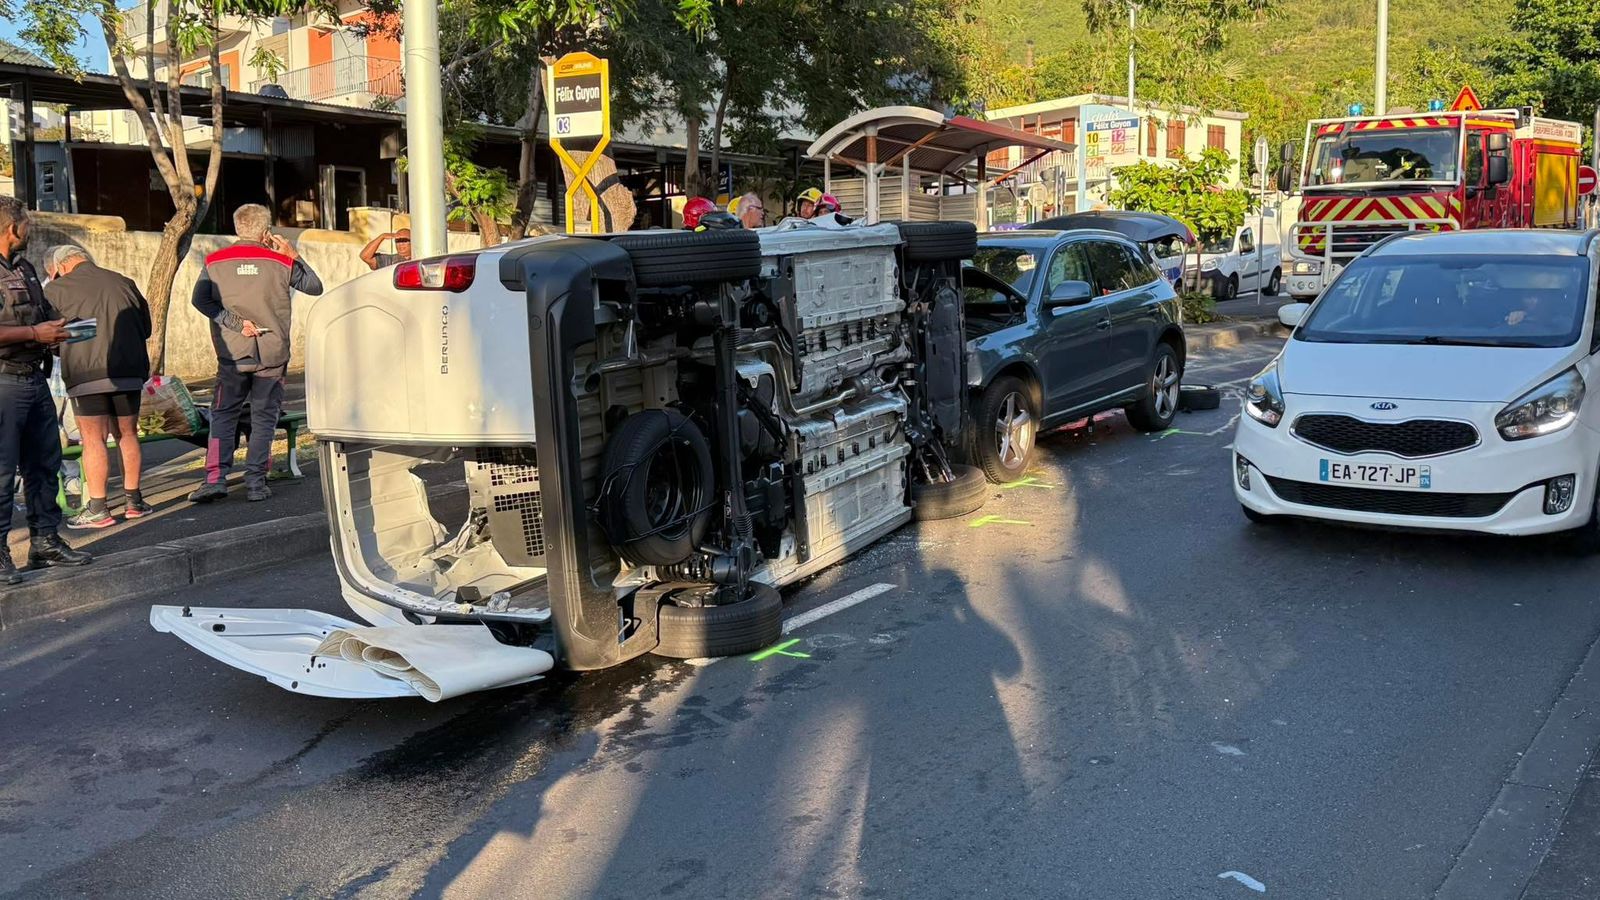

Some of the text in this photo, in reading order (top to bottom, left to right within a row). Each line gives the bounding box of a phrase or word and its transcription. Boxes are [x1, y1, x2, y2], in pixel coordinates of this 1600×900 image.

[556, 85, 600, 102] Félix Guyon
[557, 117, 570, 133] 03
[1093, 120, 1131, 130] Félix Guyon
[1087, 132, 1099, 144] 10
[1113, 130, 1125, 141] 12
[1087, 146, 1098, 156] 21
[1112, 144, 1124, 153] 22
[440, 305, 449, 375] BERLINGO
[1332, 463, 1416, 484] EA-727-JP
